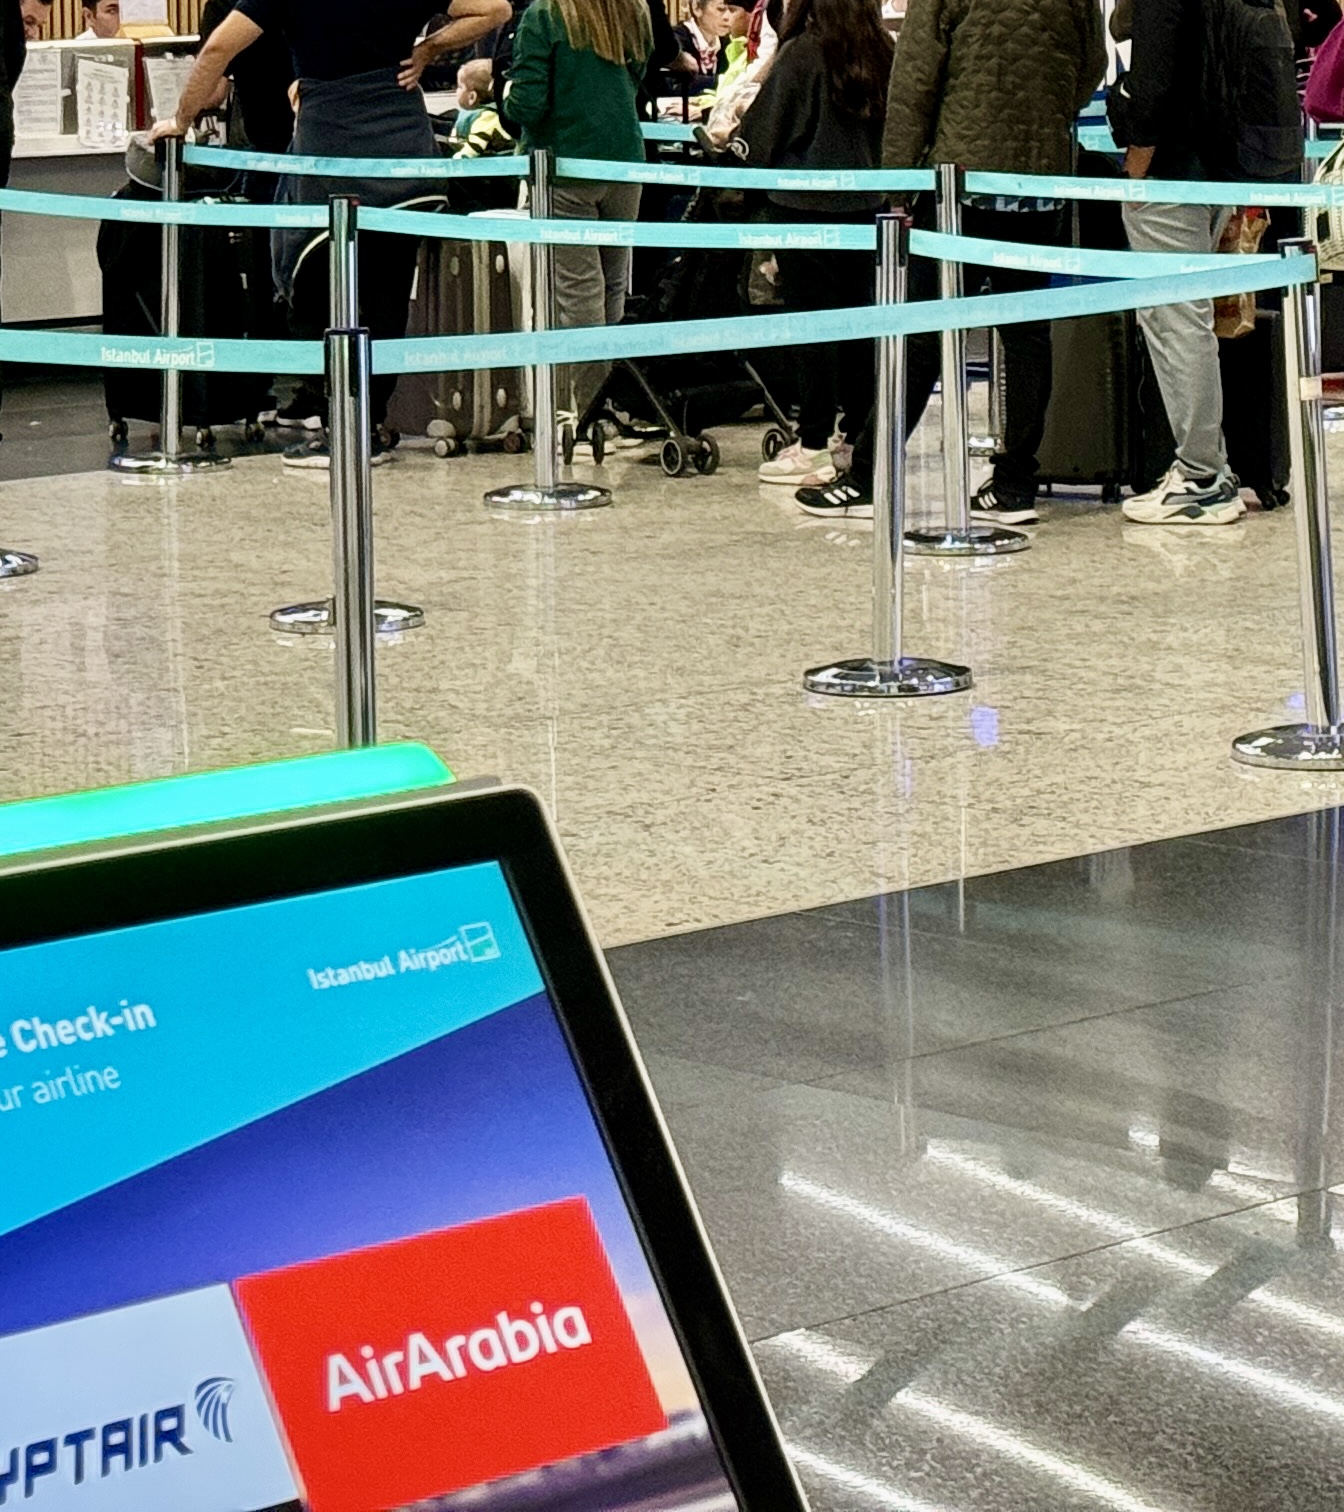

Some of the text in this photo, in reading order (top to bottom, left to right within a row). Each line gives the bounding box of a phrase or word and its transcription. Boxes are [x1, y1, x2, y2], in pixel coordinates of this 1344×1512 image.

[100, 346, 197, 367] Istanbul Airport
[307, 941, 468, 990] Istanbul Airport
[10, 999, 157, 1053] Check-in
[33, 1064, 122, 1104] airline
[325, 1300, 592, 1413] AirArabia
